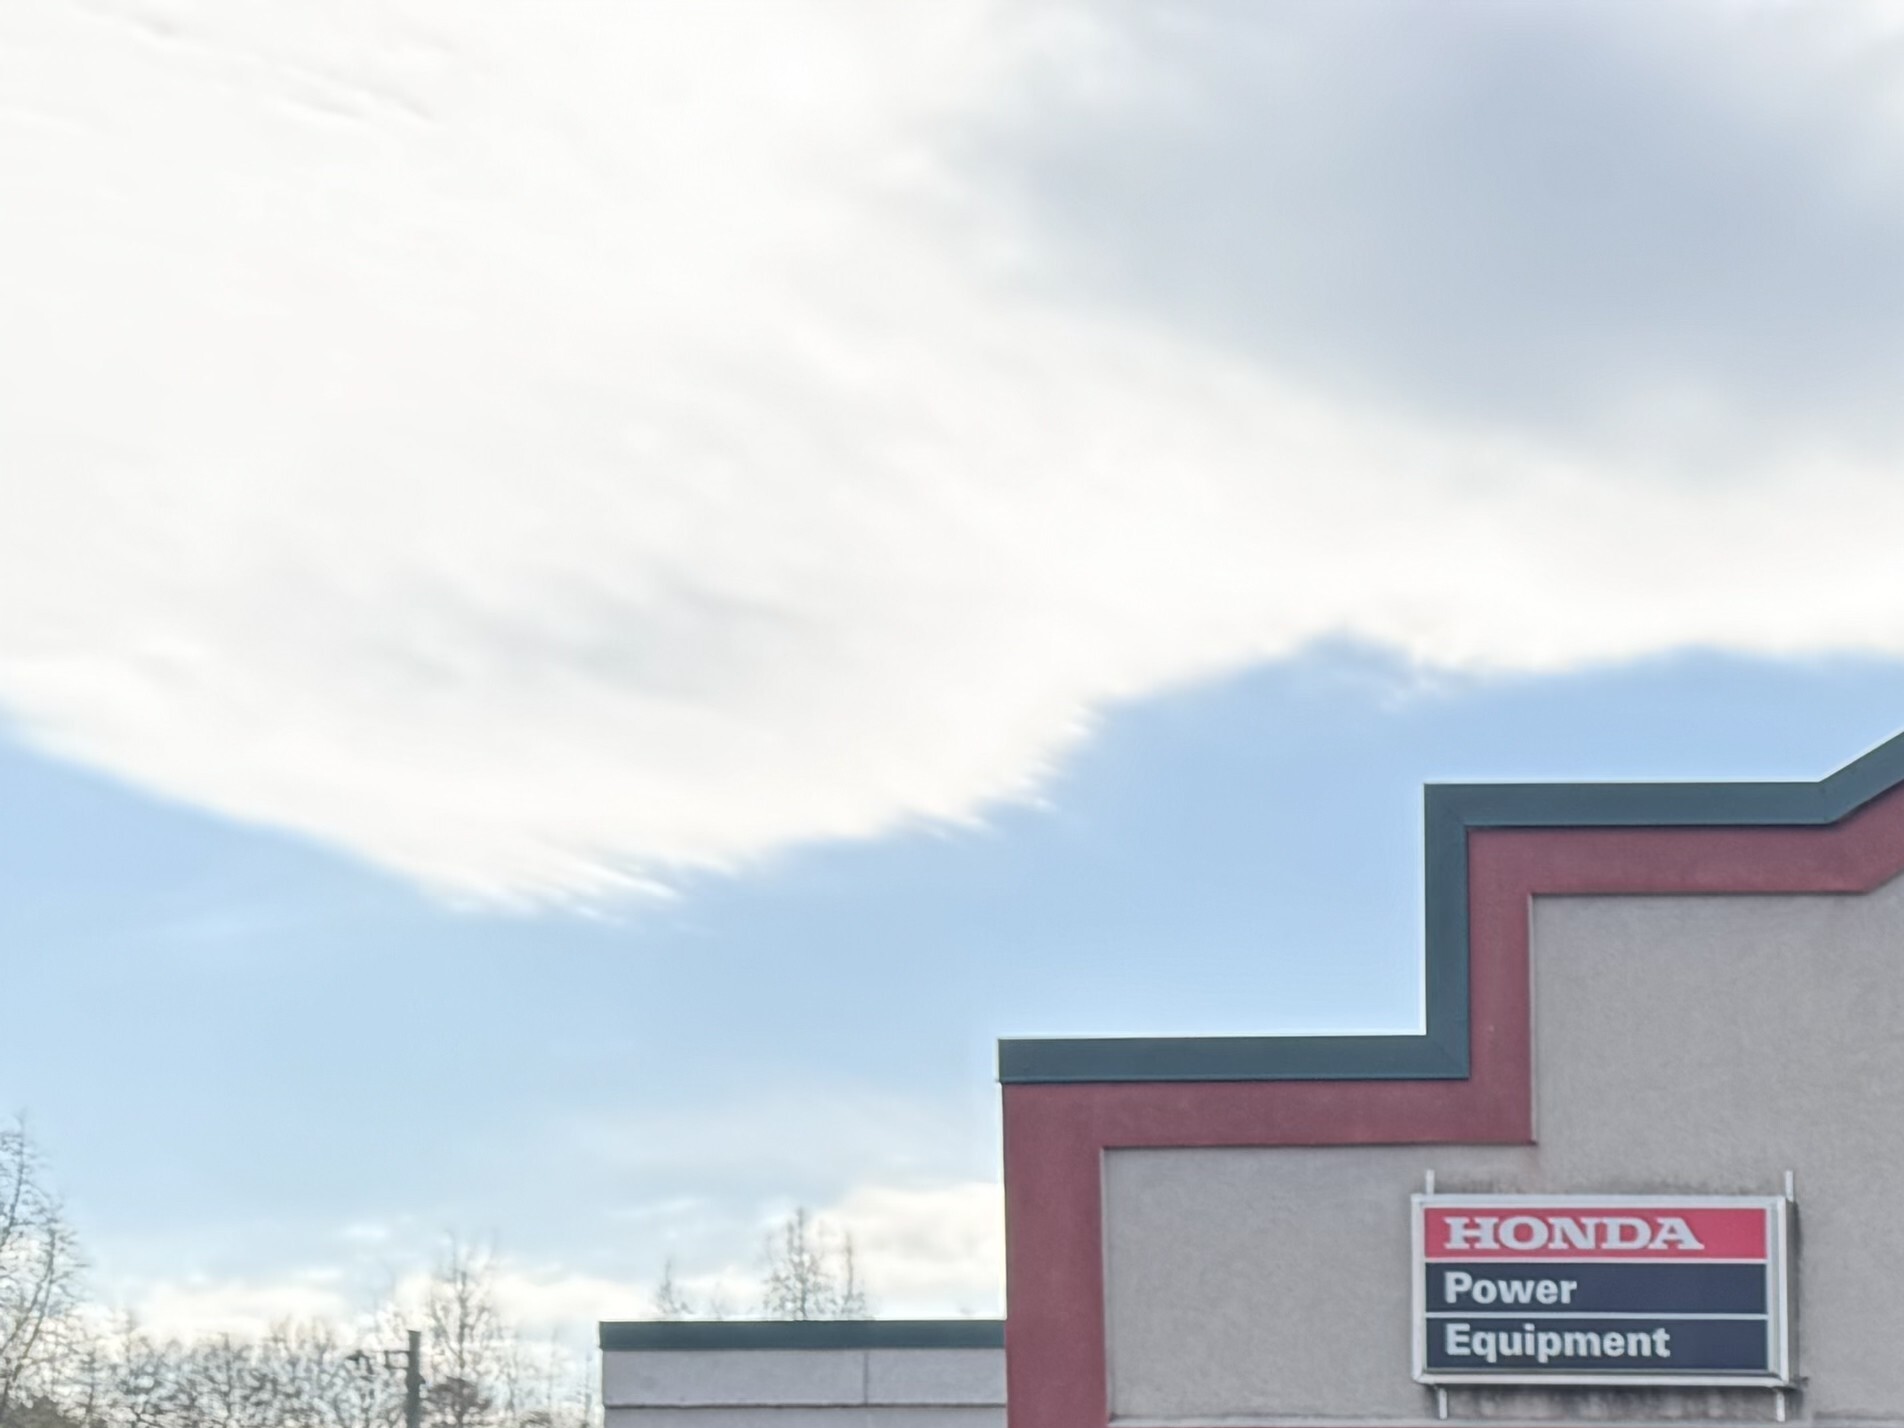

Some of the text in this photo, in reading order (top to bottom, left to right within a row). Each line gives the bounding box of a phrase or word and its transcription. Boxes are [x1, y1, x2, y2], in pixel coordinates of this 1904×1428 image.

[1443, 1215, 1705, 1251] HONDA
[1444, 1270, 1578, 1305] Power
[1444, 1322, 1671, 1364] Equipment
